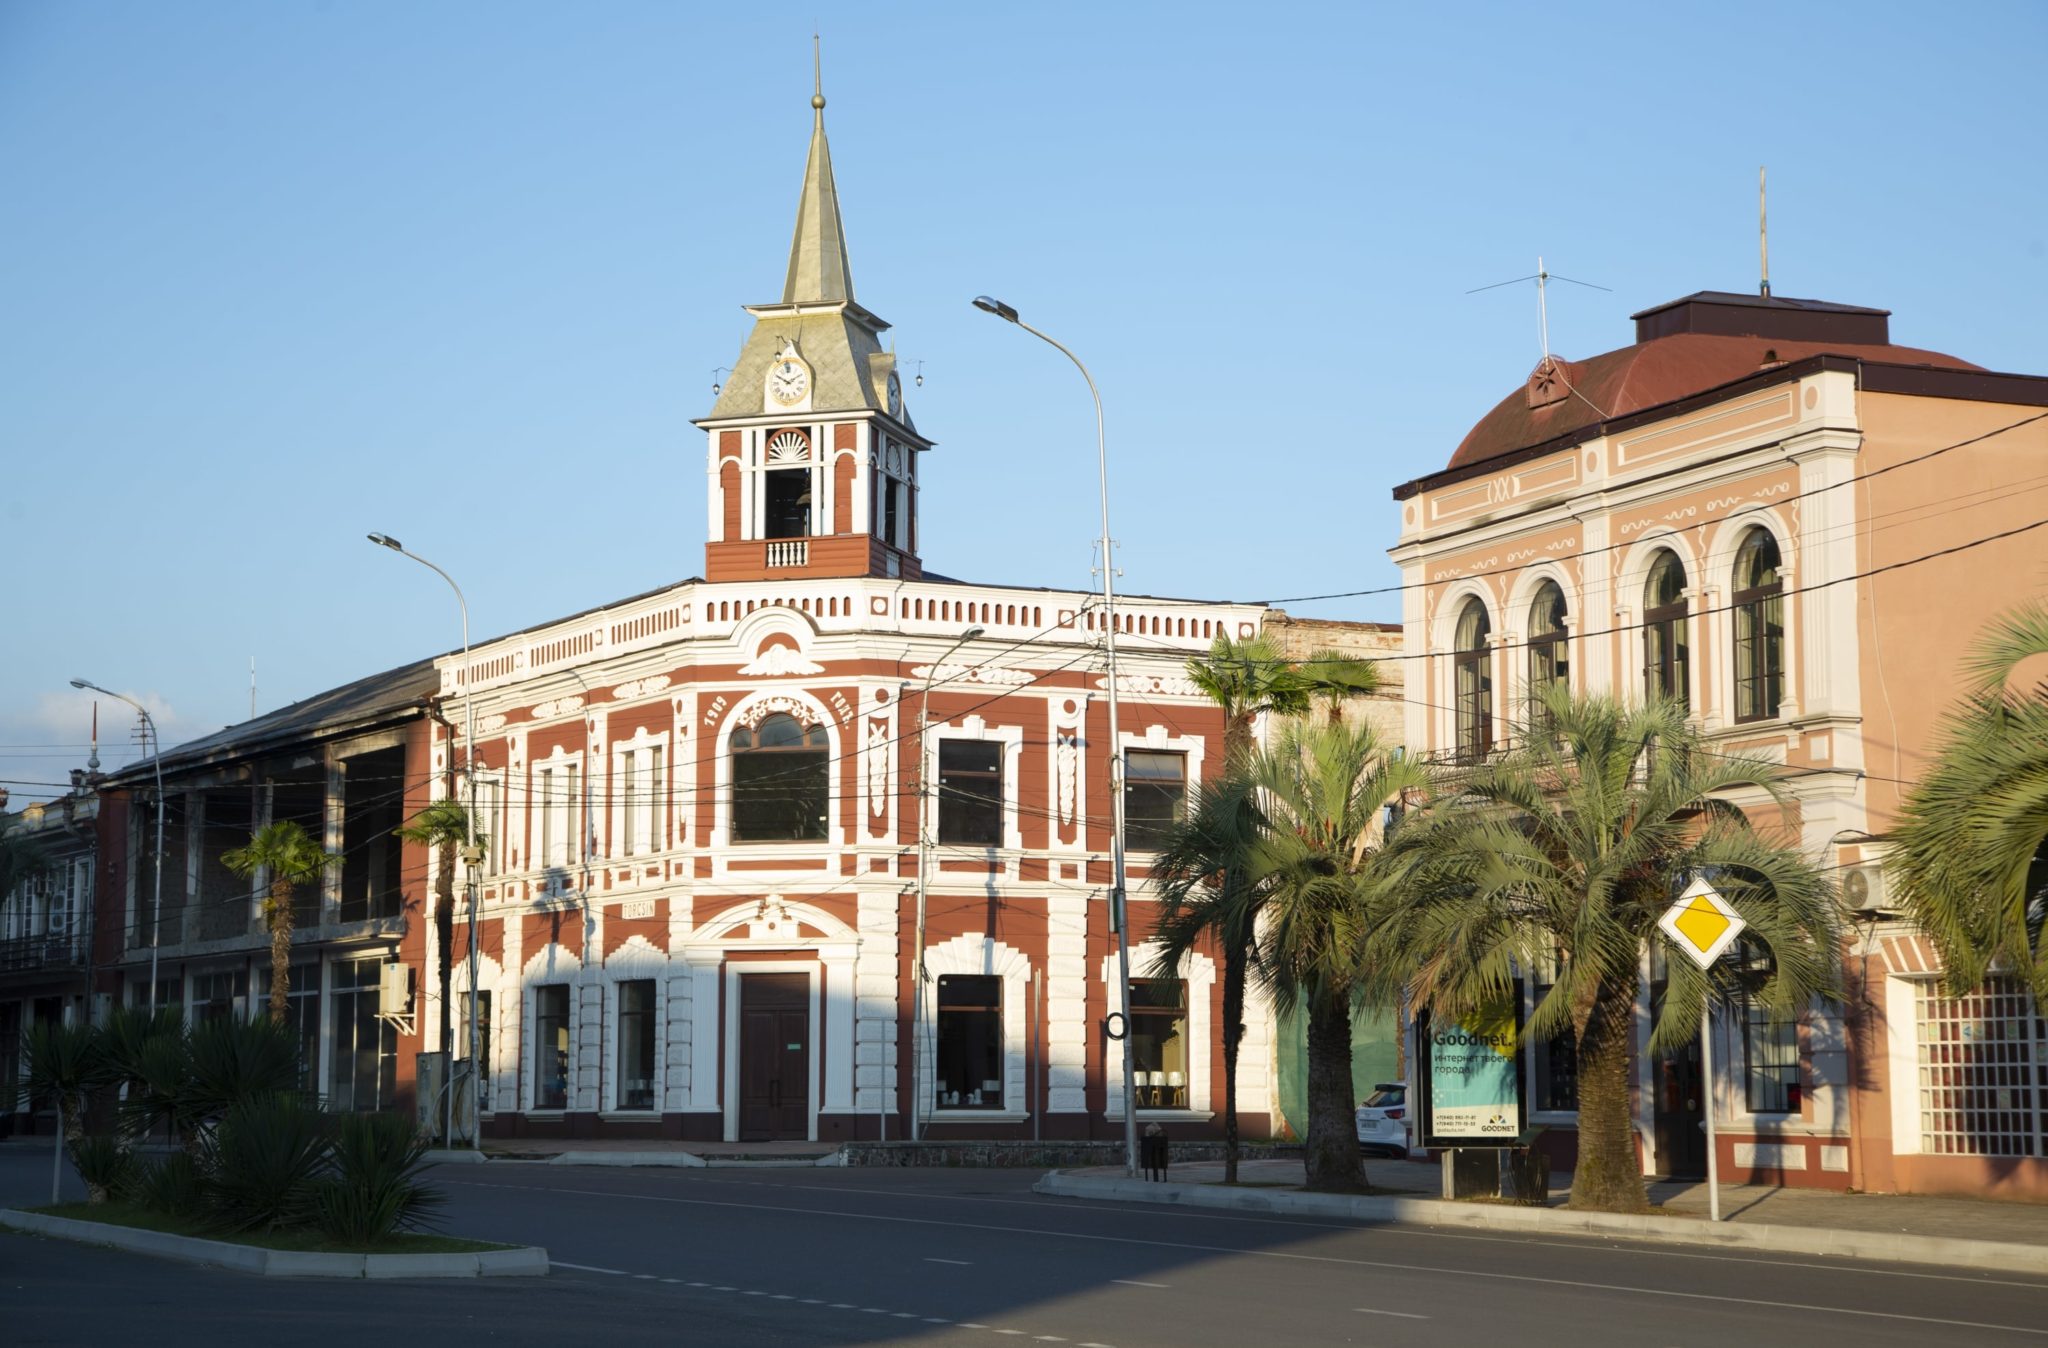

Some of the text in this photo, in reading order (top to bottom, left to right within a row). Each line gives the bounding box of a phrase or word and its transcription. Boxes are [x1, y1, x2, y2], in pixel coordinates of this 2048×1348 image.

[704, 695, 727, 727] 1909
[1434, 1032, 1512, 1046] Goodnet.
[1434, 1055, 1513, 1064] интернет твоего
[1434, 1066, 1471, 1075] города
